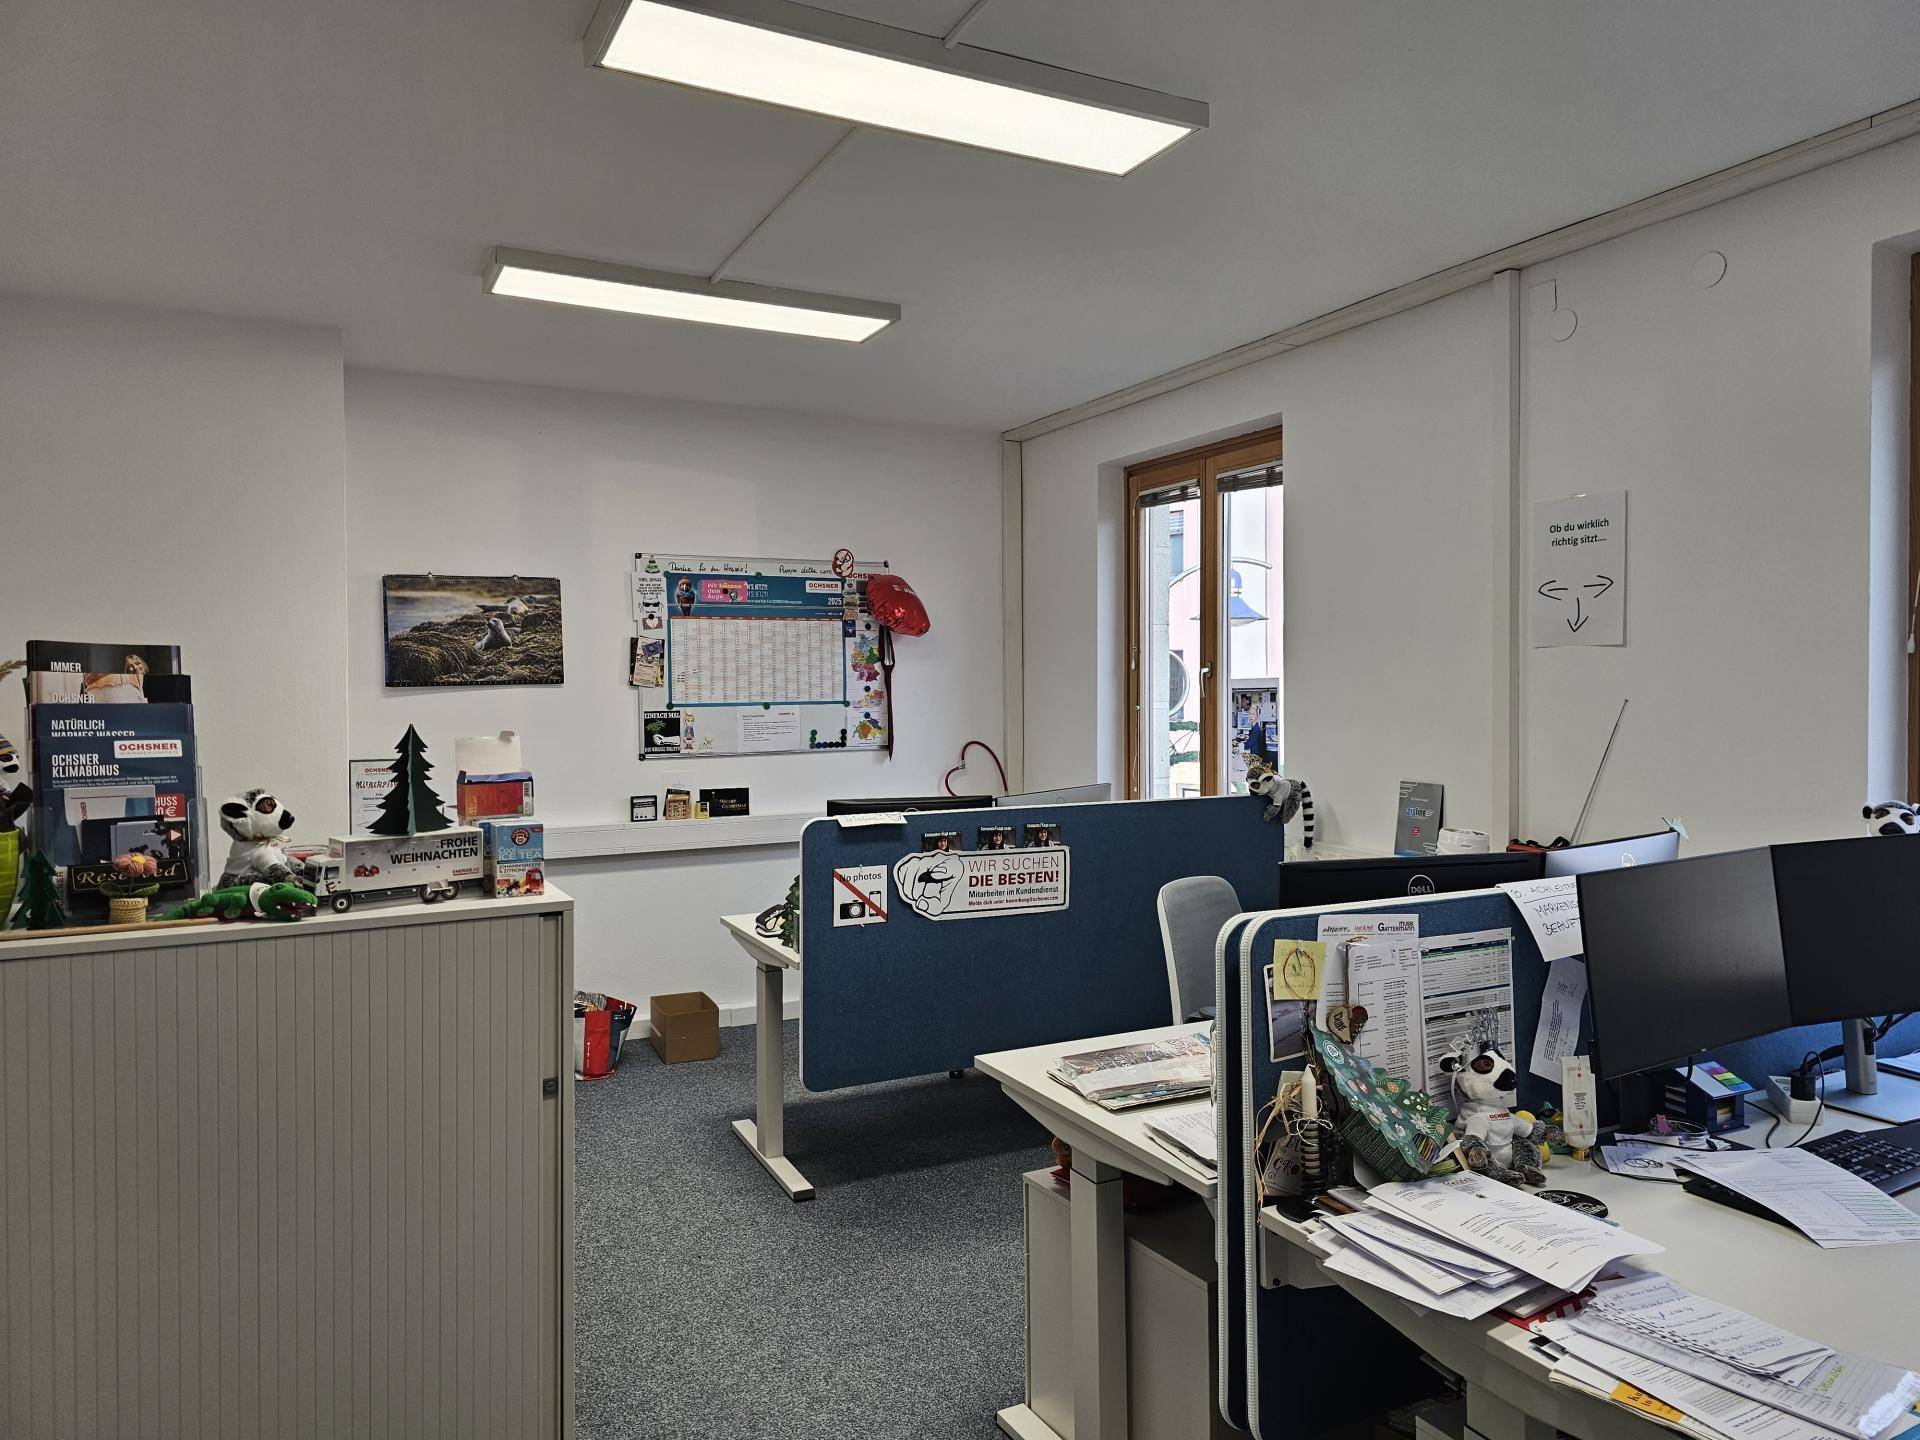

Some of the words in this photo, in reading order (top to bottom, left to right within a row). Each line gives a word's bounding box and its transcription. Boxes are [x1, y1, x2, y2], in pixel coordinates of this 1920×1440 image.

[1550, 524, 1562, 533] Ob
[1564, 522, 1575, 532] du
[1577, 518, 1609, 530] wirklich
[1552, 536, 1578, 546] richtig
[50, 662, 82, 672] IMMER
[52, 692, 95, 704] OCHSNER
[51, 718, 105, 730] NATÜRLICH
[118, 742, 178, 751] OCHSNER
[52, 754, 99, 766] OCHSNER
[52, 764, 120, 778] KLIMABONUS
[440, 836, 478, 848] FROHE
[391, 848, 478, 864] WEIHNACHTEN
[968, 860, 997, 872] WIR
[1002, 856, 1059, 871] SUCHEN
[840, 874, 852, 882] No
[853, 872, 882, 883] photos
[968, 874, 993, 888] DIE
[998, 870, 1059, 886] BESTEN!
[968, 889, 1005, 898] Mitarbeiter
[1006, 888, 1014, 896] im
[1016, 886, 1059, 896] Kundendienst
[1410, 886, 1432, 894] DELL
